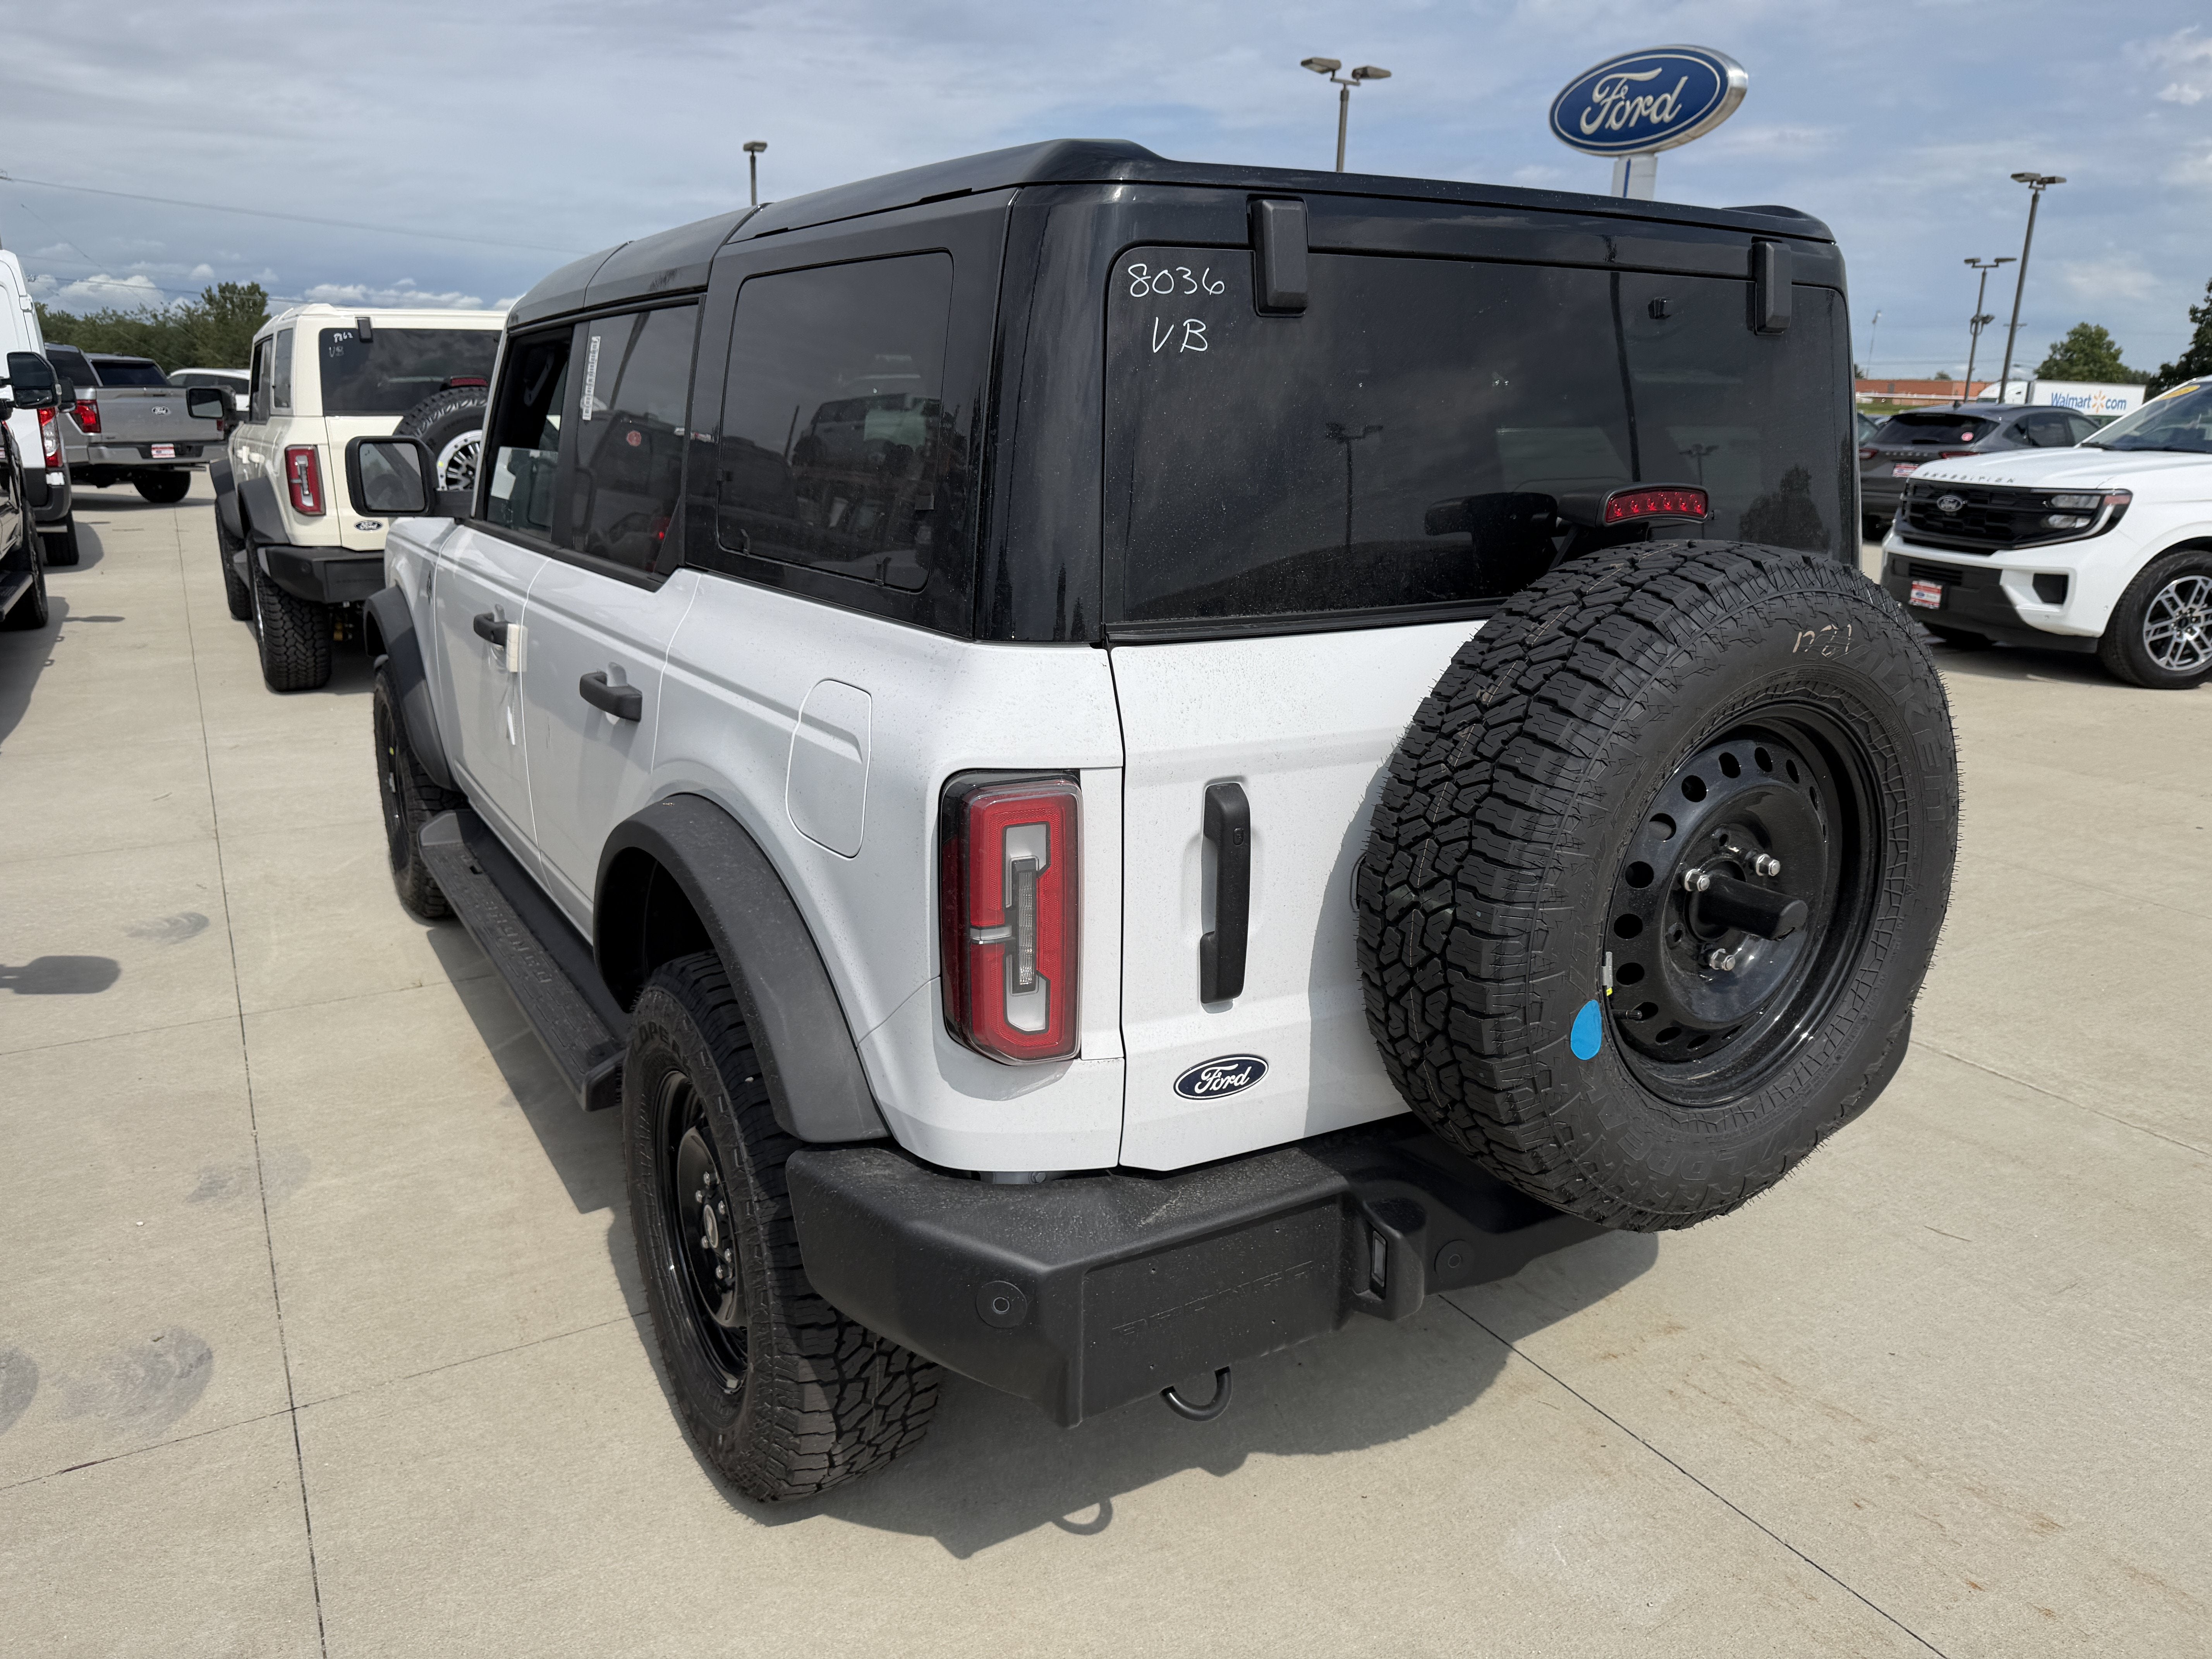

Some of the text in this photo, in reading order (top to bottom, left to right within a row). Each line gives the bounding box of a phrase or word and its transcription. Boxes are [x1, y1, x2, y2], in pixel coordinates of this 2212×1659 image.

[1580, 67, 1688, 135] Ford
[1128, 263, 1225, 297] 8036
[2052, 392, 2092, 409] Walmart
[1194, 1063, 1252, 1094] Ford
